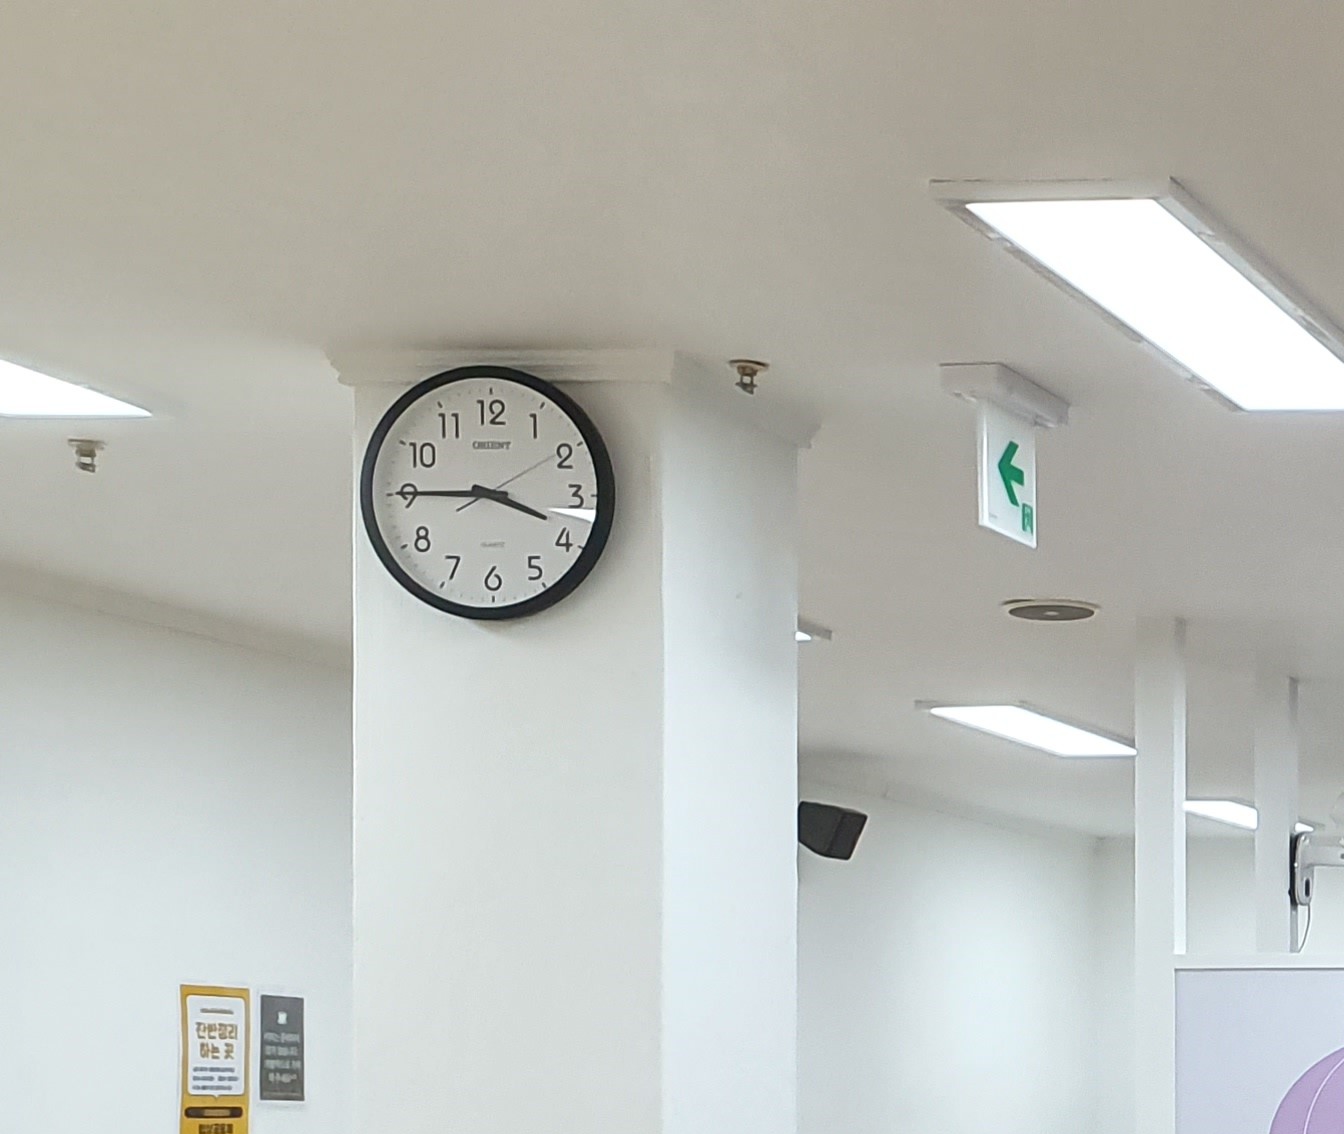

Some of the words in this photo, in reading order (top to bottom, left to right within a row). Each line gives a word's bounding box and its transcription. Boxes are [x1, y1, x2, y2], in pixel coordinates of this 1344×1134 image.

[437, 412, 461, 439] 11
[476, 399, 507, 426] 12
[529, 412, 539, 439] 1
[409, 442, 437, 469] 10
[555, 443, 574, 470] 2
[400, 482, 419, 509] 9
[567, 483, 586, 509] 3
[413, 525, 432, 553] 8
[554, 526, 574, 553] 4
[445, 555, 462, 581] 7
[483, 565, 503, 592] 6
[526, 555, 544, 581] 5
